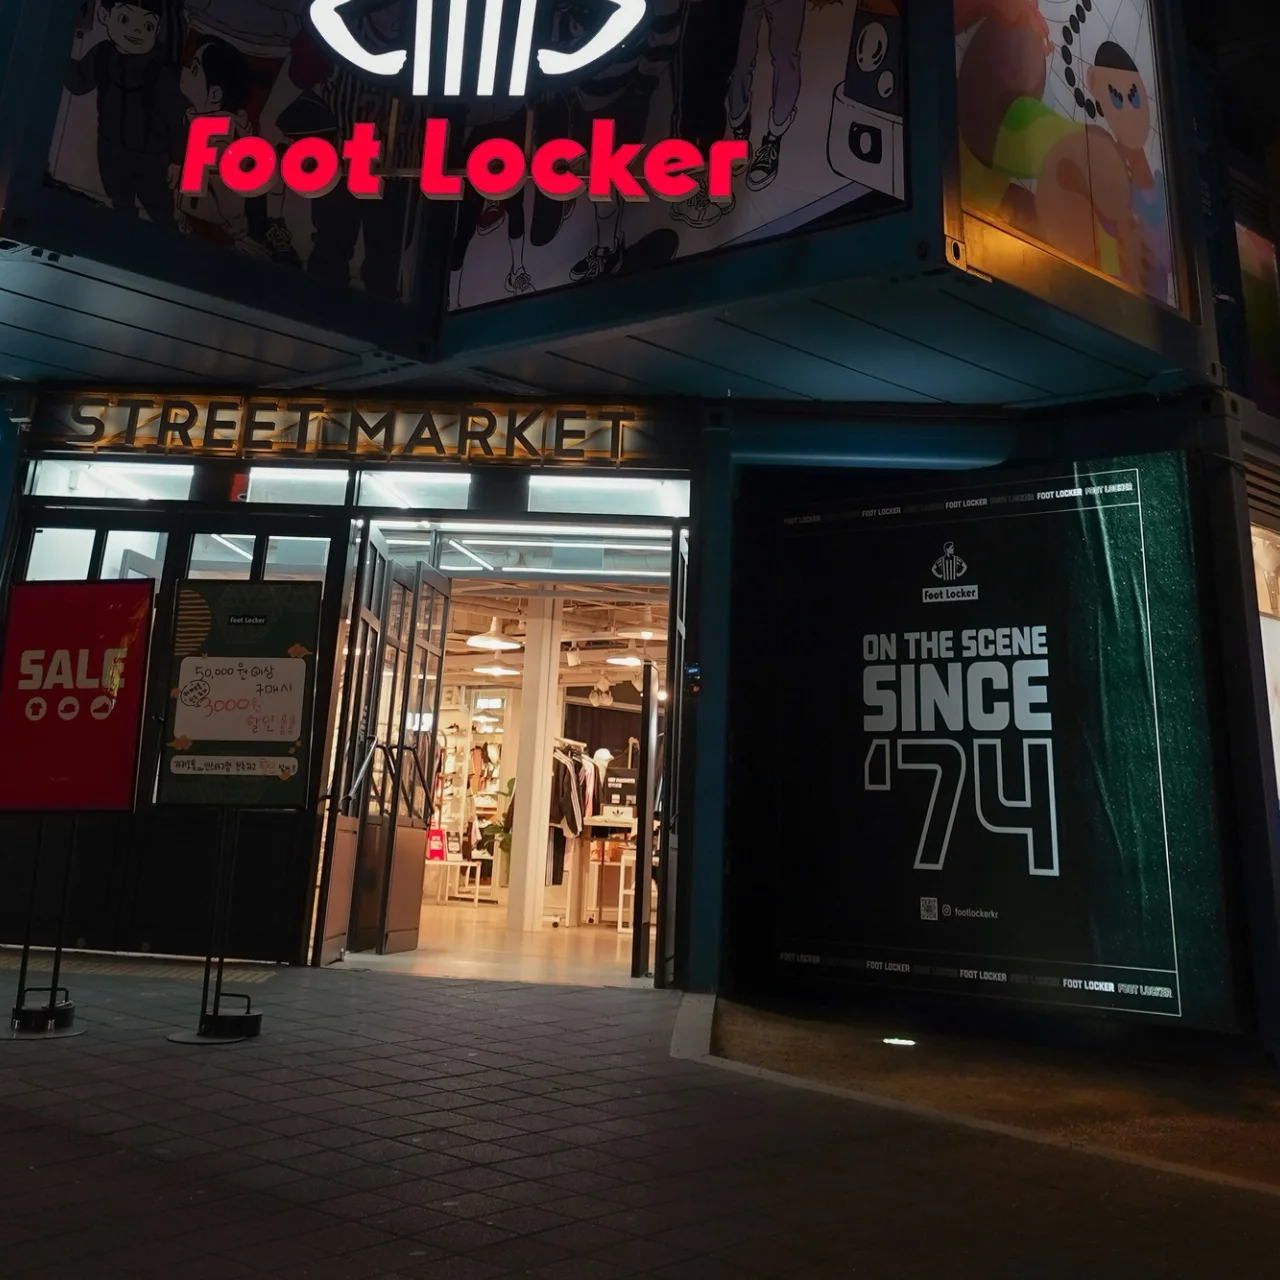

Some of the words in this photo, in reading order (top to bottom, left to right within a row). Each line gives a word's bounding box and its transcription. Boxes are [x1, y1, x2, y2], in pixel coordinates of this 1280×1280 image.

[180, 116, 384, 201] Foot
[419, 116, 750, 204] Locker
[65, 397, 326, 453] STREET
[348, 404, 639, 463] MARKET
[1036, 490, 1055, 500] FOOT
[1055, 488, 1083, 498] LOCKER
[944, 500, 962, 510] FOOT
[962, 498, 988, 508] LOCKER
[861, 509, 878, 518] FOOT
[878, 506, 902, 516] LOCKER
[924, 590, 943, 600] Foot
[946, 588, 976, 599] Locker
[230, 616, 244, 624] Foot
[244, 616, 266, 624] Locker
[862, 631, 898, 662] ON
[903, 628, 954, 660] THE
[960, 623, 1049, 659] SCENE
[17, 647, 129, 692] SALE
[861, 657, 1053, 734] SINCE
[862, 736, 1062, 878] '74
[954, 907, 999, 919] footlockerkr
[865, 959, 883, 971] FOOT
[884, 960, 911, 974] LOCKER
[959, 968, 978, 980] FOOT
[979, 970, 1008, 983] LOCKER
[1062, 978, 1083, 990] FOOT
[1084, 980, 1115, 993] LOCKER
